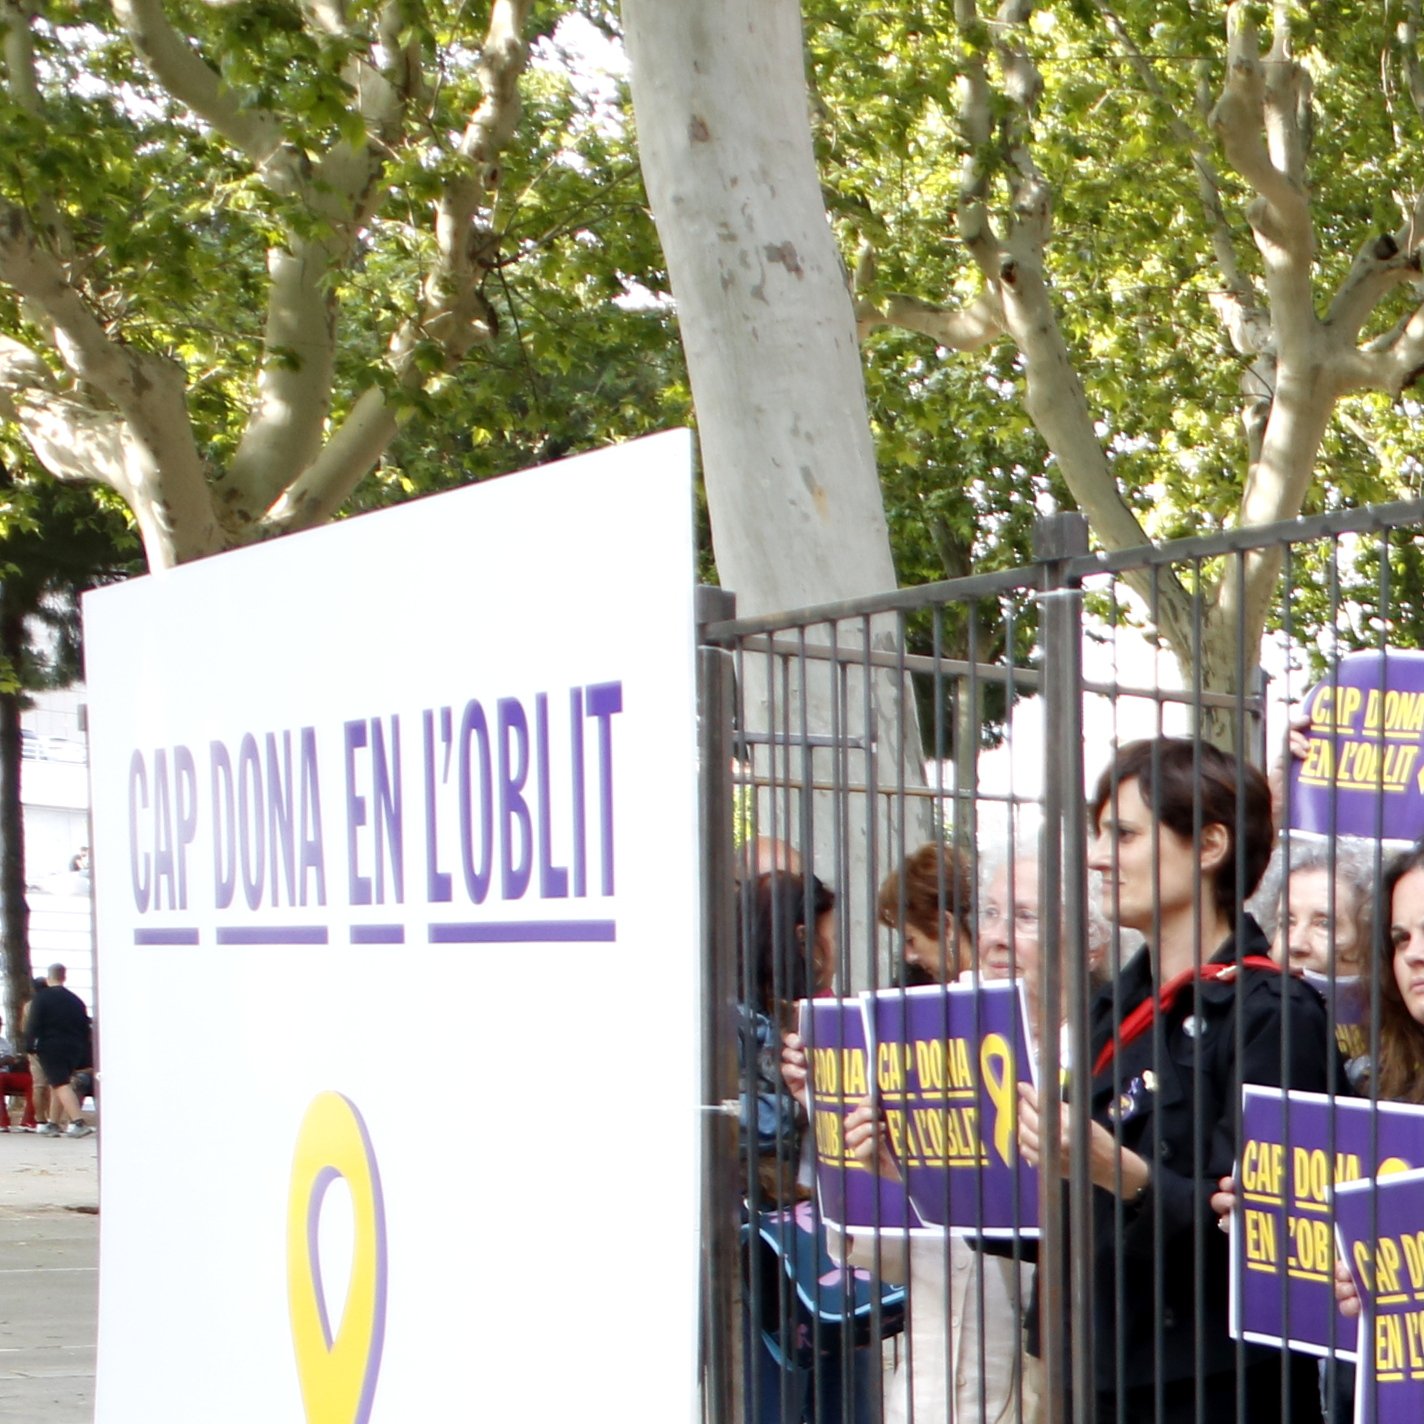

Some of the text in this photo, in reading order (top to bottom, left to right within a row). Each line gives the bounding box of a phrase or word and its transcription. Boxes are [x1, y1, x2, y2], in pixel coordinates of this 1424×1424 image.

[129, 680, 623, 914] CAP DONA EN L'OBLIT
[1245, 1209, 1275, 1262] EN
[1376, 1314, 1404, 1370] EN
